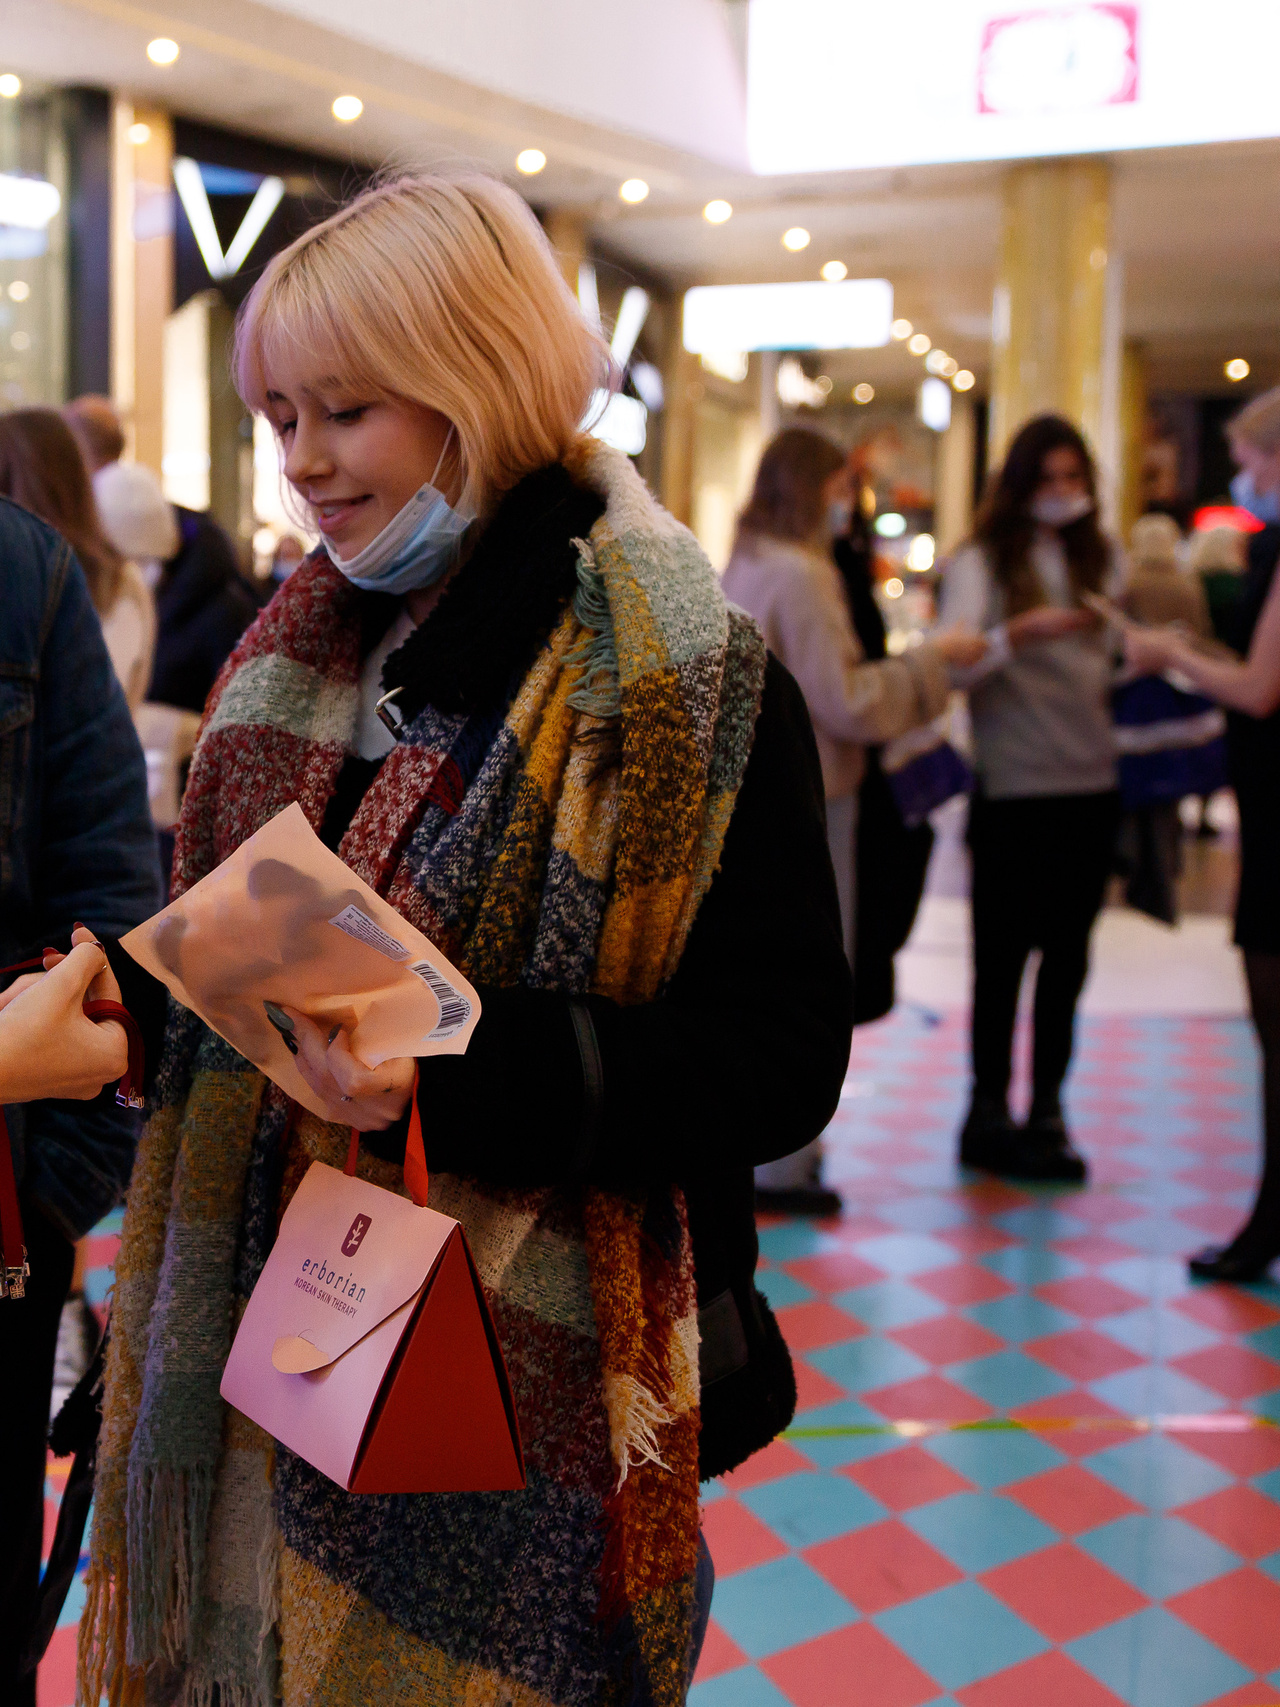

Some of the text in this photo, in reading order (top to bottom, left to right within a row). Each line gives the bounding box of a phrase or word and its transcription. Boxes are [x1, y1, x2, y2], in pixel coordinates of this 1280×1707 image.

[293, 1276, 358, 1319] KOREAN SKIN THERAPY
[301, 1258, 366, 1303] erborian
